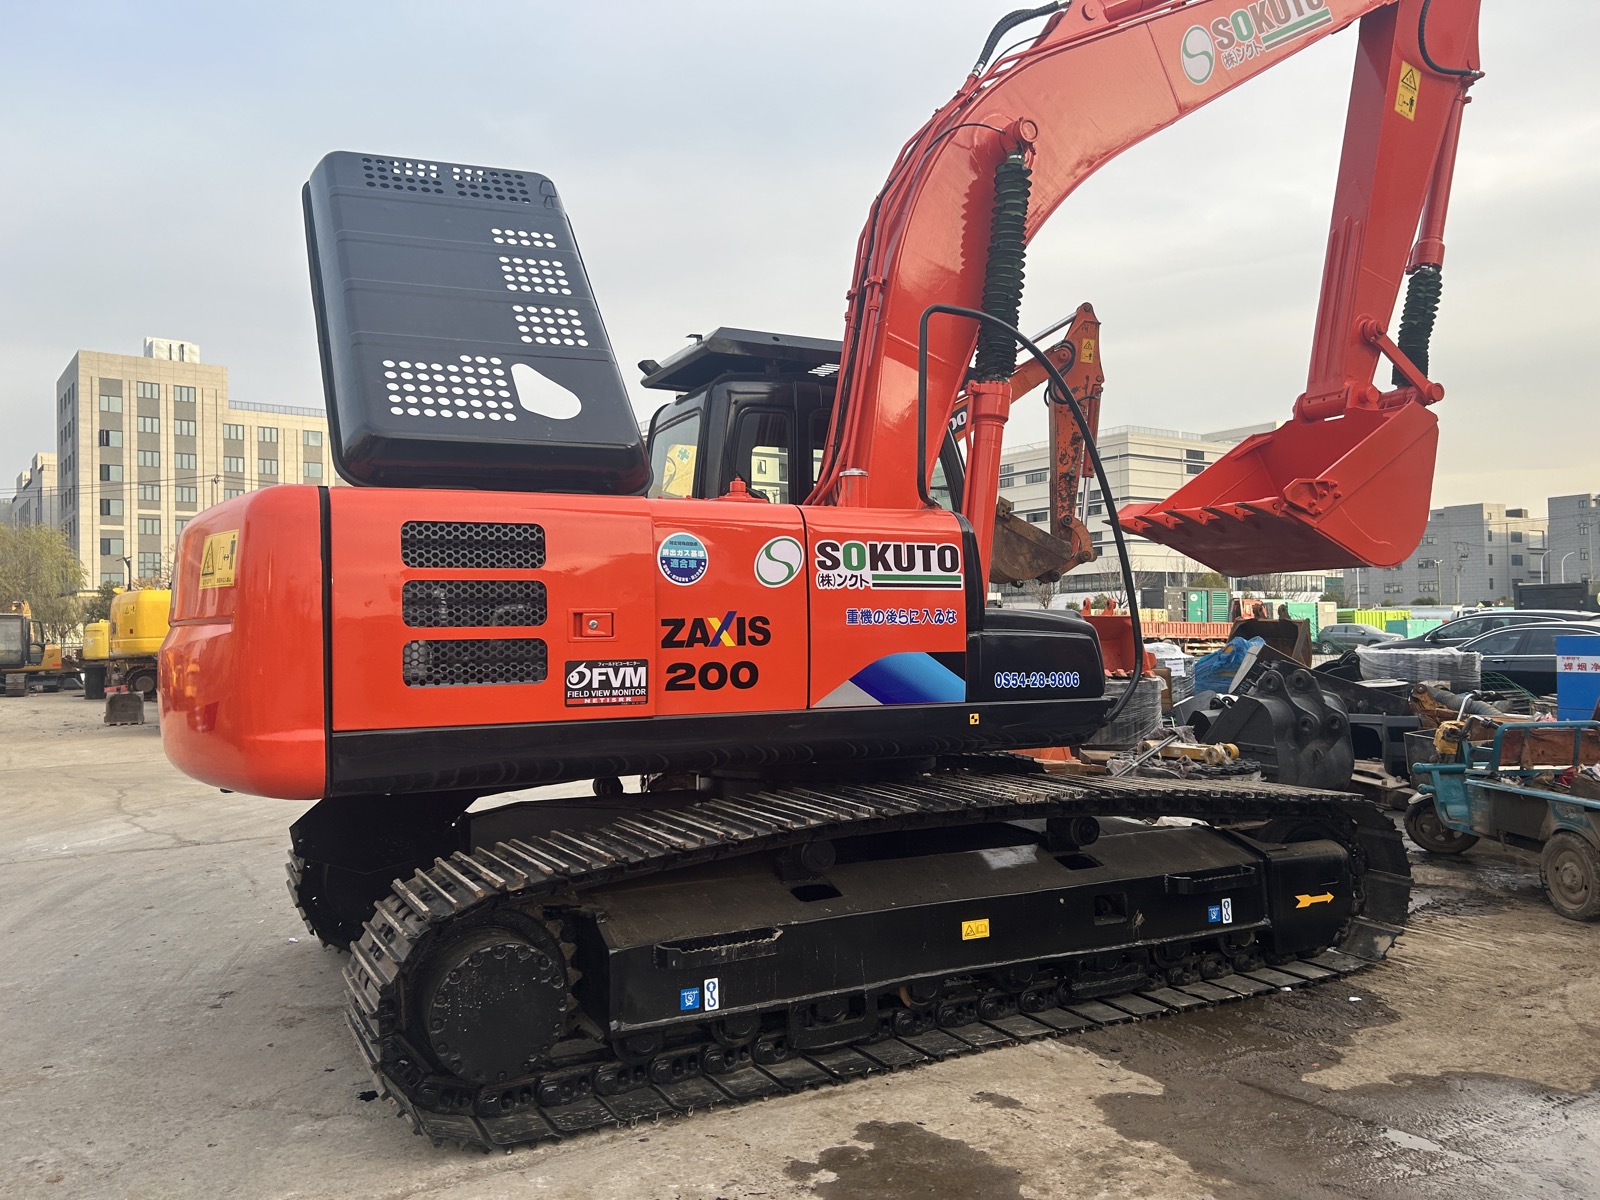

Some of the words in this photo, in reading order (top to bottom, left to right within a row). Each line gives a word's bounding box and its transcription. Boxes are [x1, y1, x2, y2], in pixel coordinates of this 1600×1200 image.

[816, 541, 960, 572] SOKUTO
[661, 611, 771, 648] ZAXIS
[592, 667, 646, 688] FVM
[665, 661, 759, 691] 200
[612, 688, 646, 696] MONITOR
